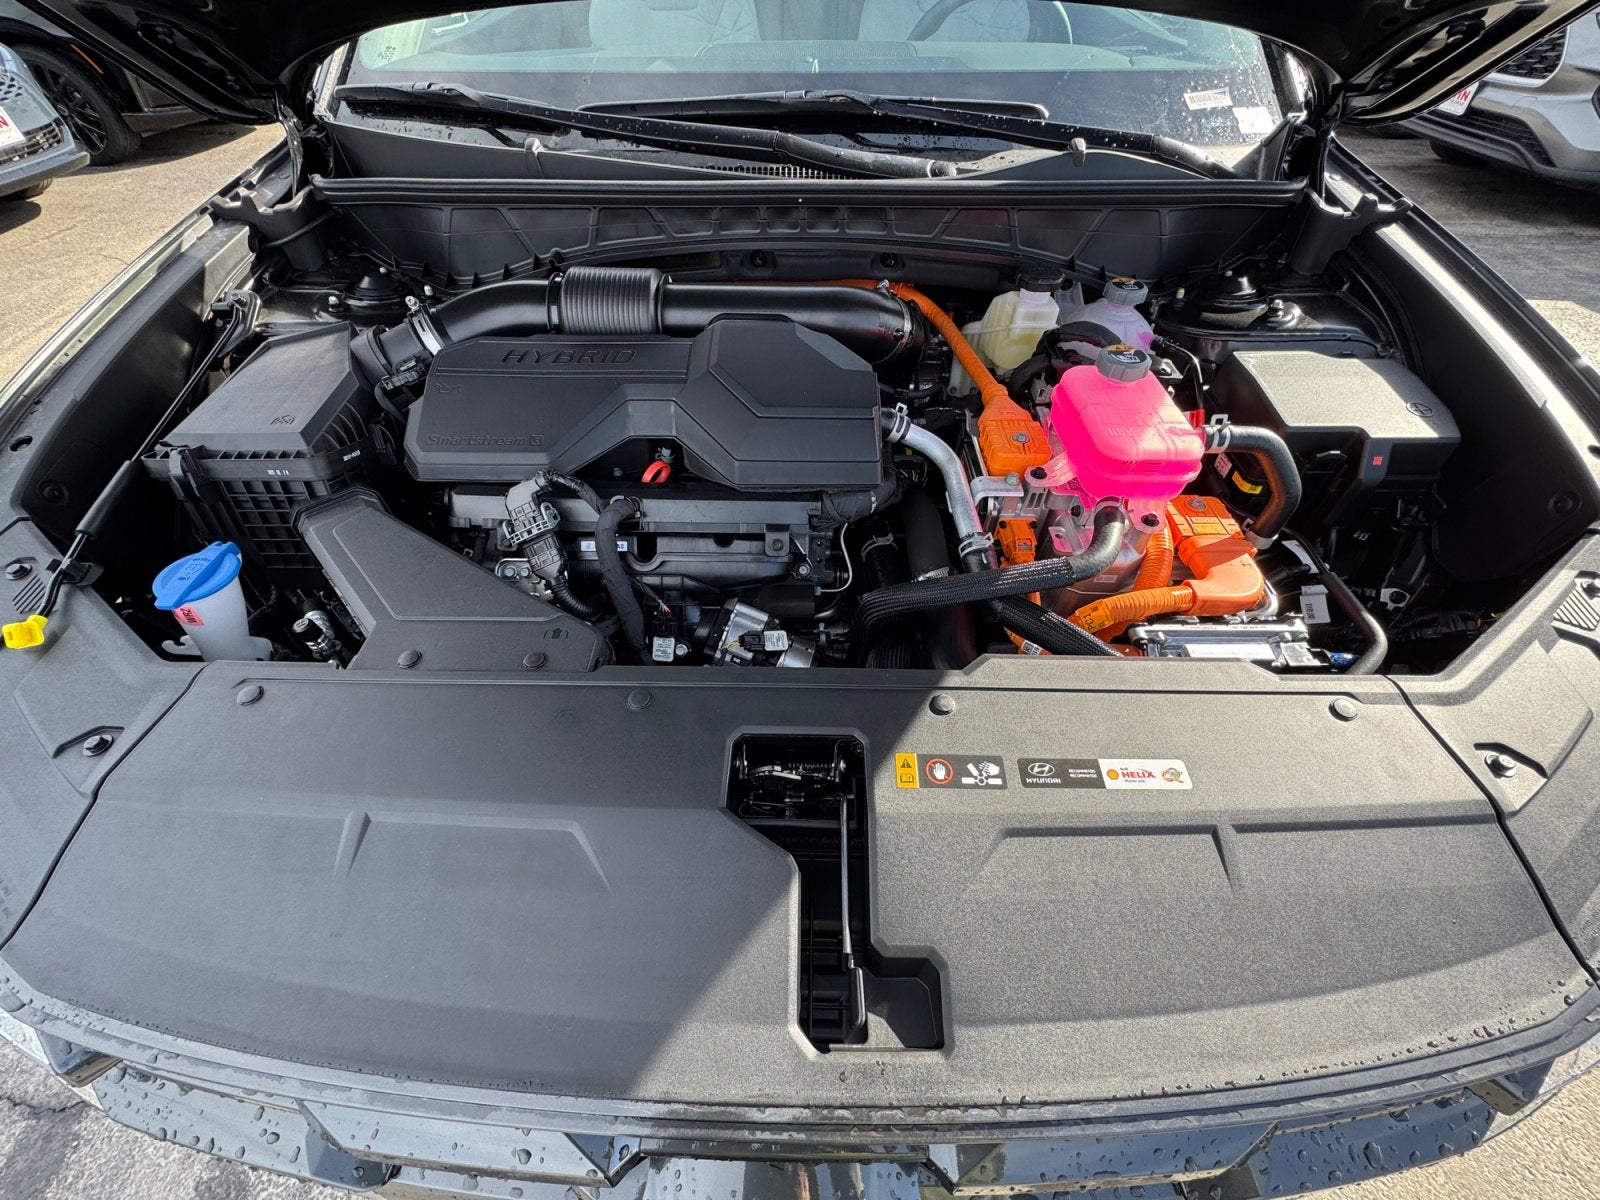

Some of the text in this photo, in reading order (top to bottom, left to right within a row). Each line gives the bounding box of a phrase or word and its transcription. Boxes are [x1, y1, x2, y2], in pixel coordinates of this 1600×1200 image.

[500, 349, 638, 364] HYBRID
[426, 434, 528, 446] Smartstream
[1121, 771, 1156, 779] HELIX
